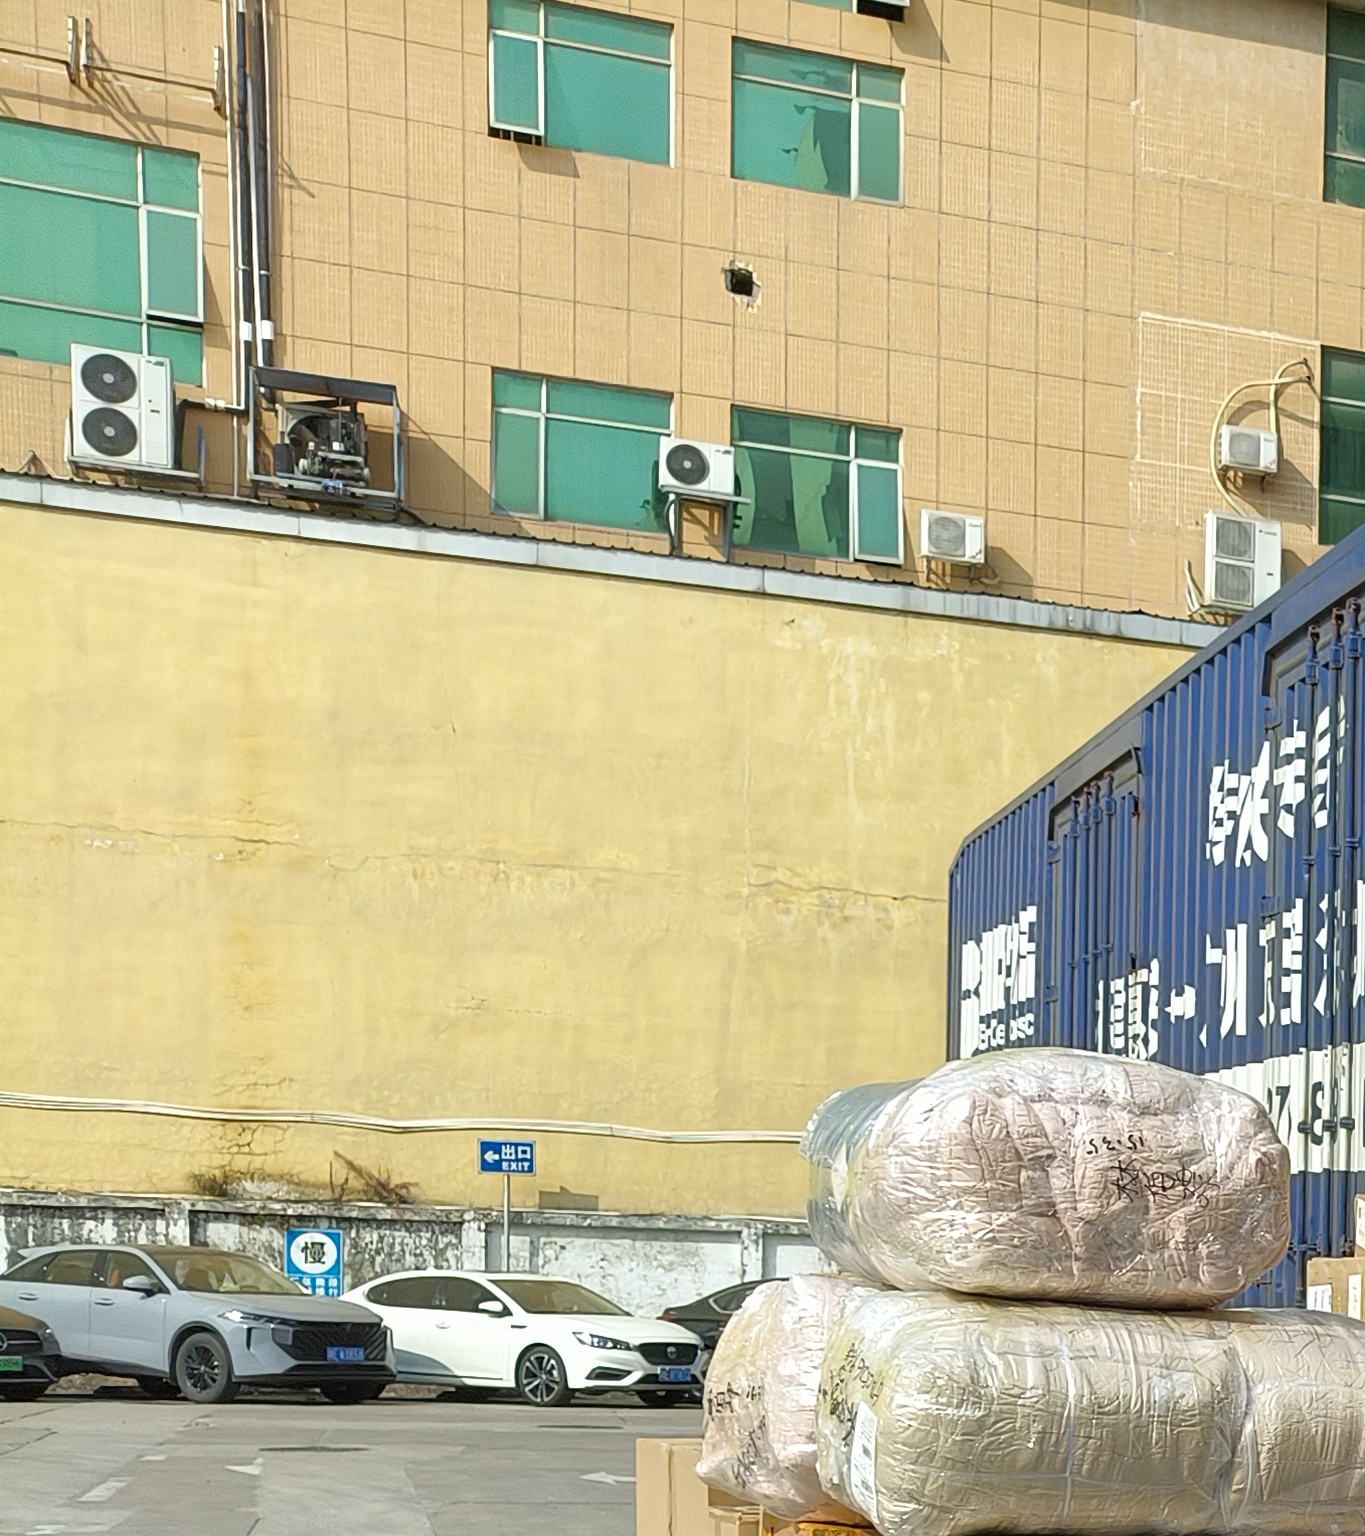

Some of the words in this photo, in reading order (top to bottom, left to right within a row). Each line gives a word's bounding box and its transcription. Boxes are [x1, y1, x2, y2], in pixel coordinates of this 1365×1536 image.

[501, 1144, 530, 1160] 出口
[502, 1161, 530, 1171] EXIT
[301, 1241, 326, 1264] 慢
